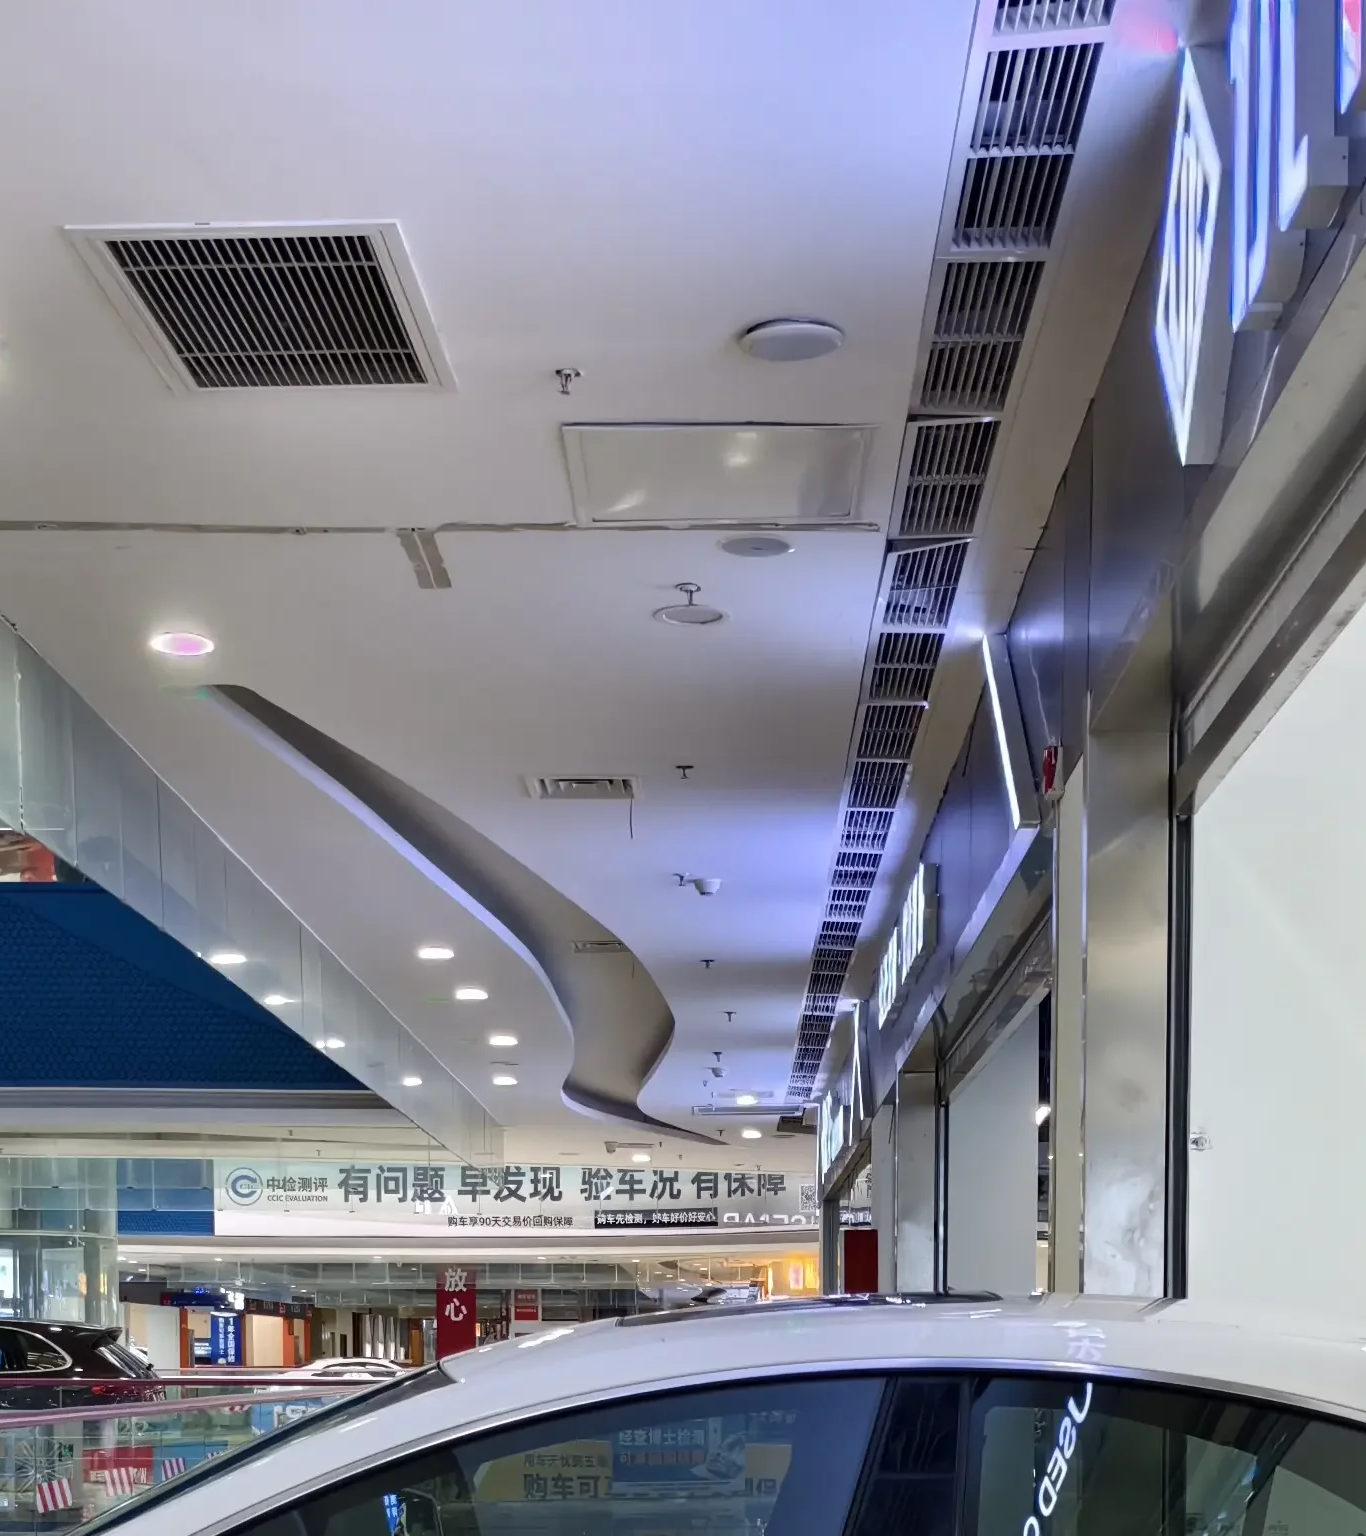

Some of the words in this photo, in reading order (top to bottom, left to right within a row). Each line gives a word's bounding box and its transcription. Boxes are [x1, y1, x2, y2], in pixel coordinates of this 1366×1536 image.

[266, 1176, 328, 1193] 中检测评
[337, 1164, 447, 1204] 有问题
[457, 1164, 564, 1204] 早发现
[580, 1167, 683, 1202] 验车况
[690, 1170, 788, 1200] 有保障
[285, 1194, 329, 1202] EVALUATION
[444, 1267, 468, 1322] 放心
